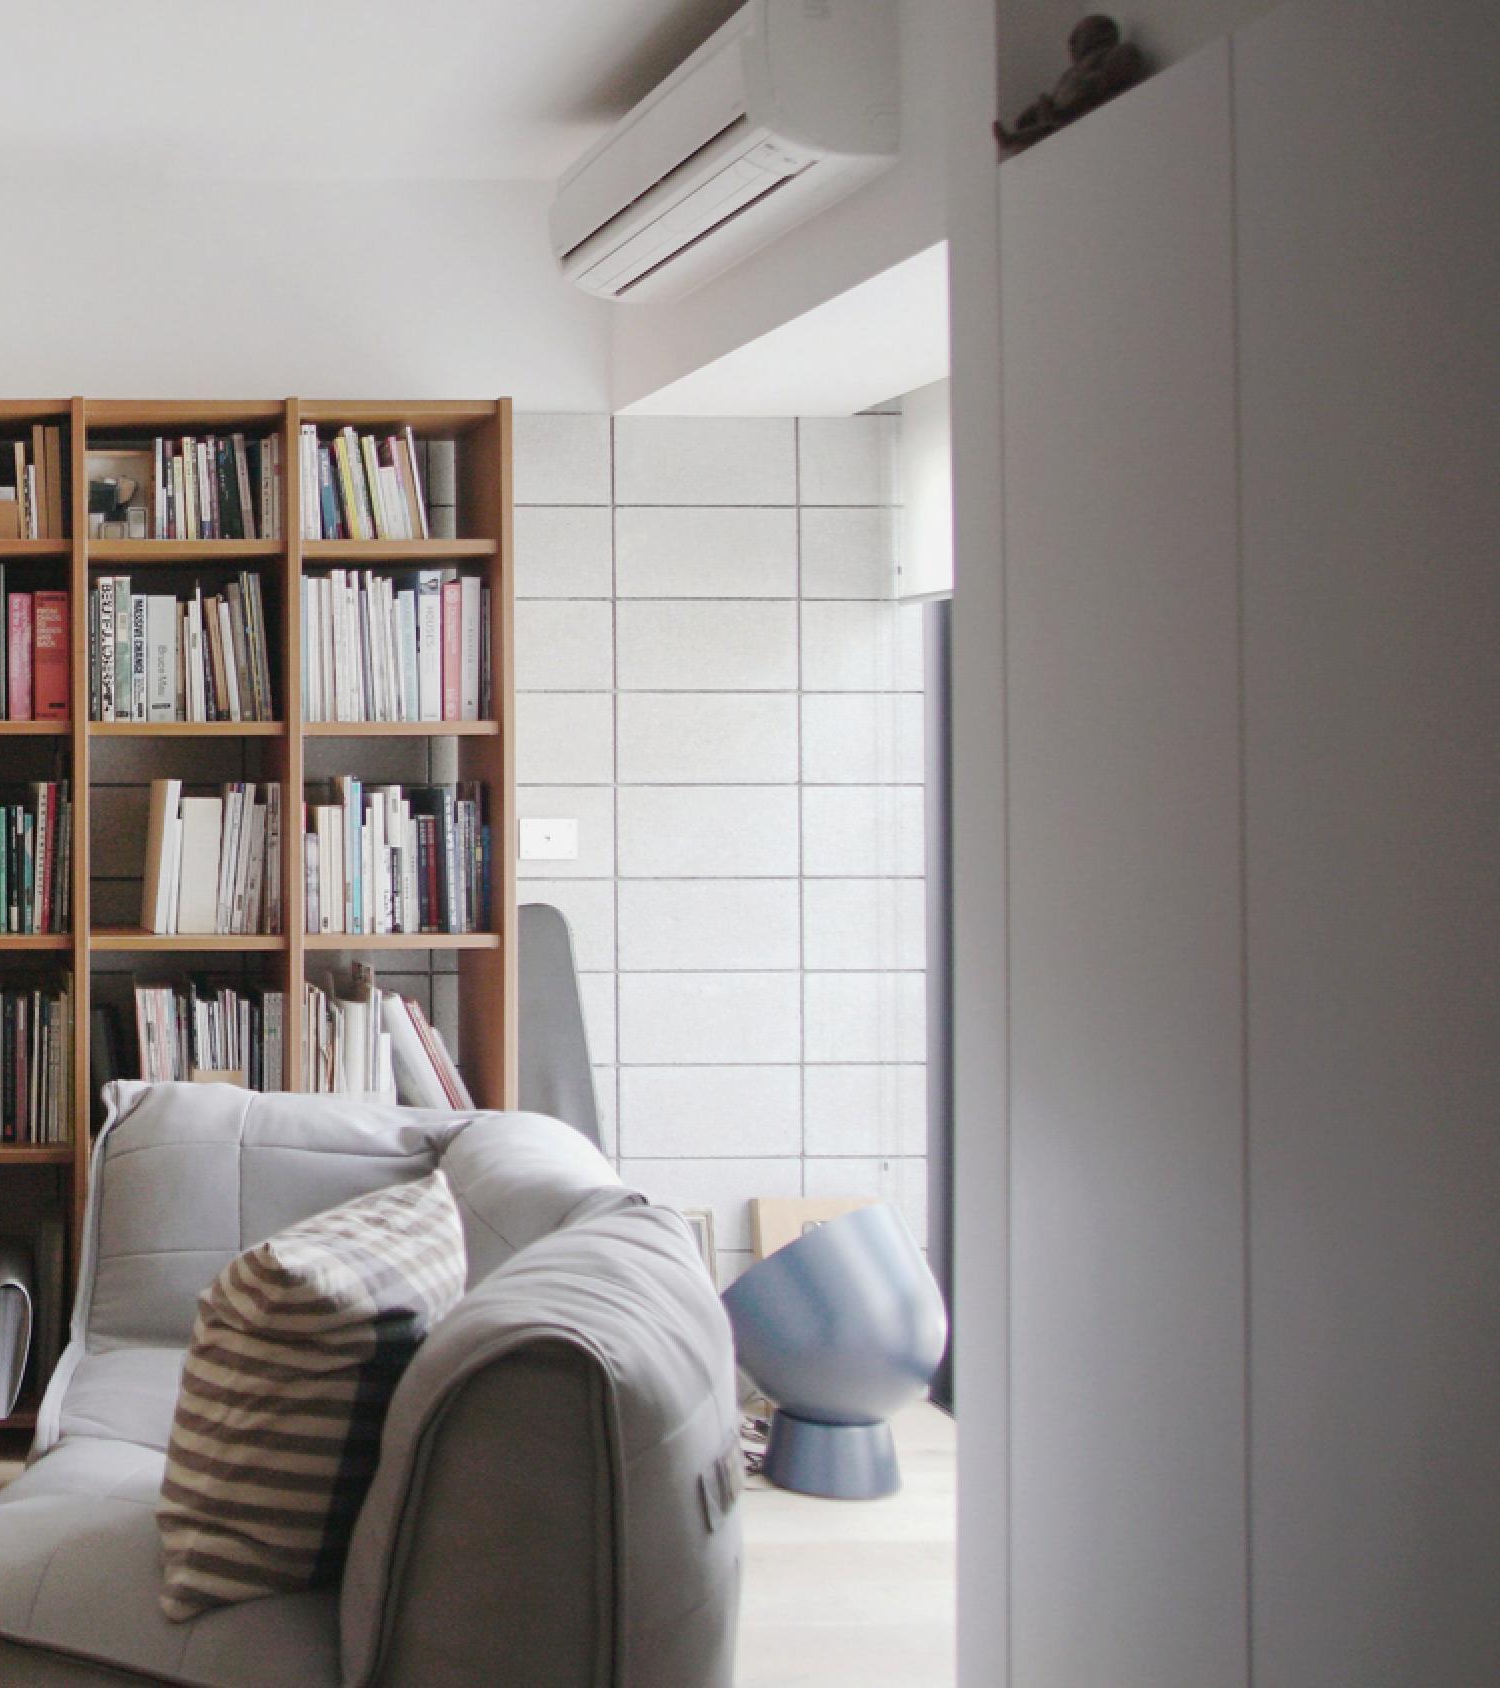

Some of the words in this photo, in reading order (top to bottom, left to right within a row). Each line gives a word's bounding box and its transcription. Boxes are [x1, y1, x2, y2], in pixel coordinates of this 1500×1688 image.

[426, 605, 436, 648] HOUSES
[133, 640, 145, 674] CHANGE
[157, 644, 168, 674] Bruce
[157, 676, 168, 697] Mau
